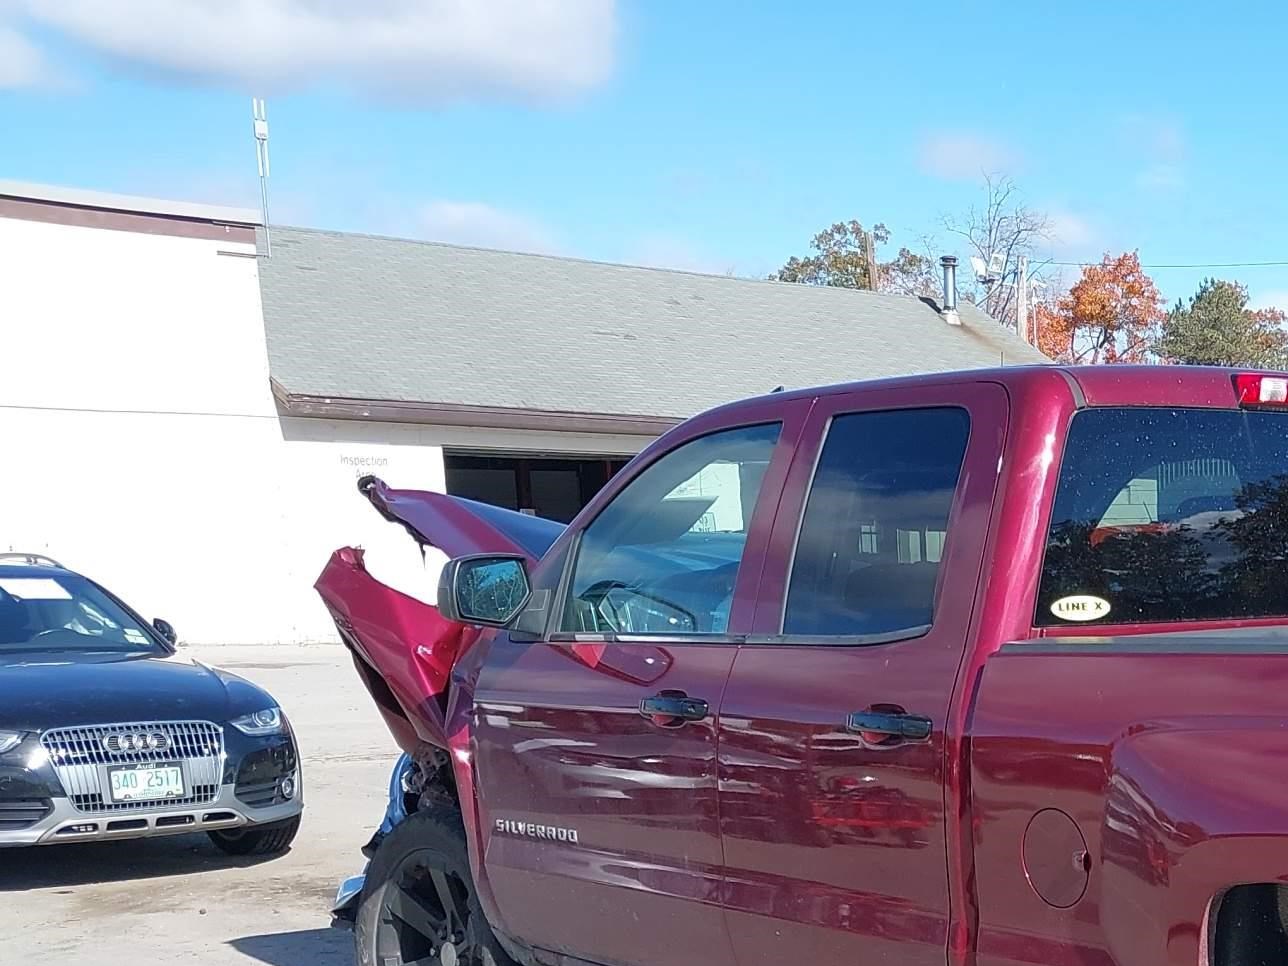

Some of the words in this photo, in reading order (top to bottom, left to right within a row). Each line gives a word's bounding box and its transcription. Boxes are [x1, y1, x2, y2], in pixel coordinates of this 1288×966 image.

[340, 455, 388, 467] Inspection
[1058, 602, 1088, 611] LINE
[1095, 602, 1102, 610] X
[112, 772, 137, 790] 340
[146, 769, 179, 788] 2517
[495, 818, 578, 843] SILVERADO
